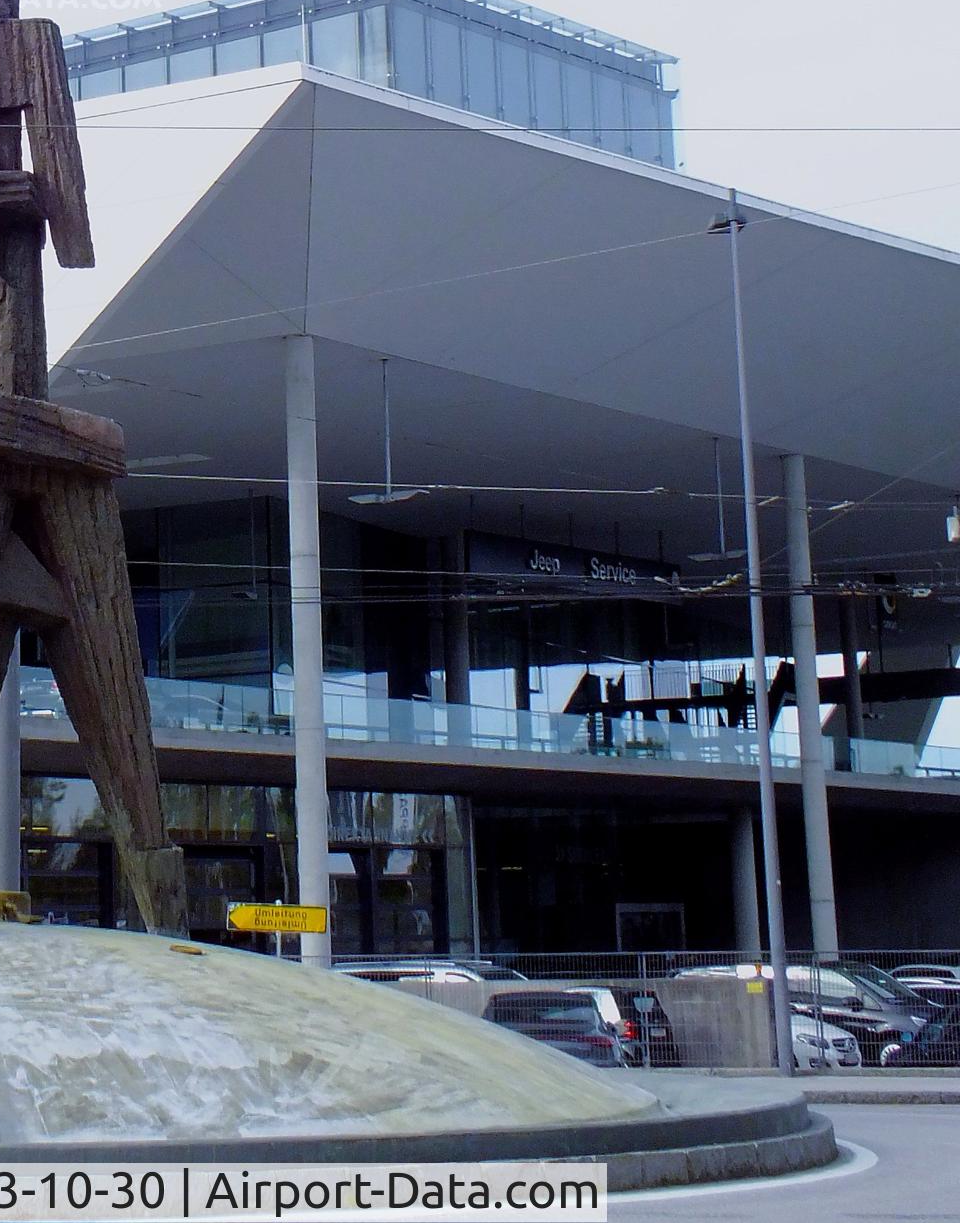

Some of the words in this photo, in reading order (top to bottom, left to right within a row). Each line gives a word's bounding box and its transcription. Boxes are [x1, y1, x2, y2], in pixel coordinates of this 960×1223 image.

[530, 549, 560, 576] Jeep
[590, 557, 636, 585] Service
[255, 908, 307, 920] Umleitung
